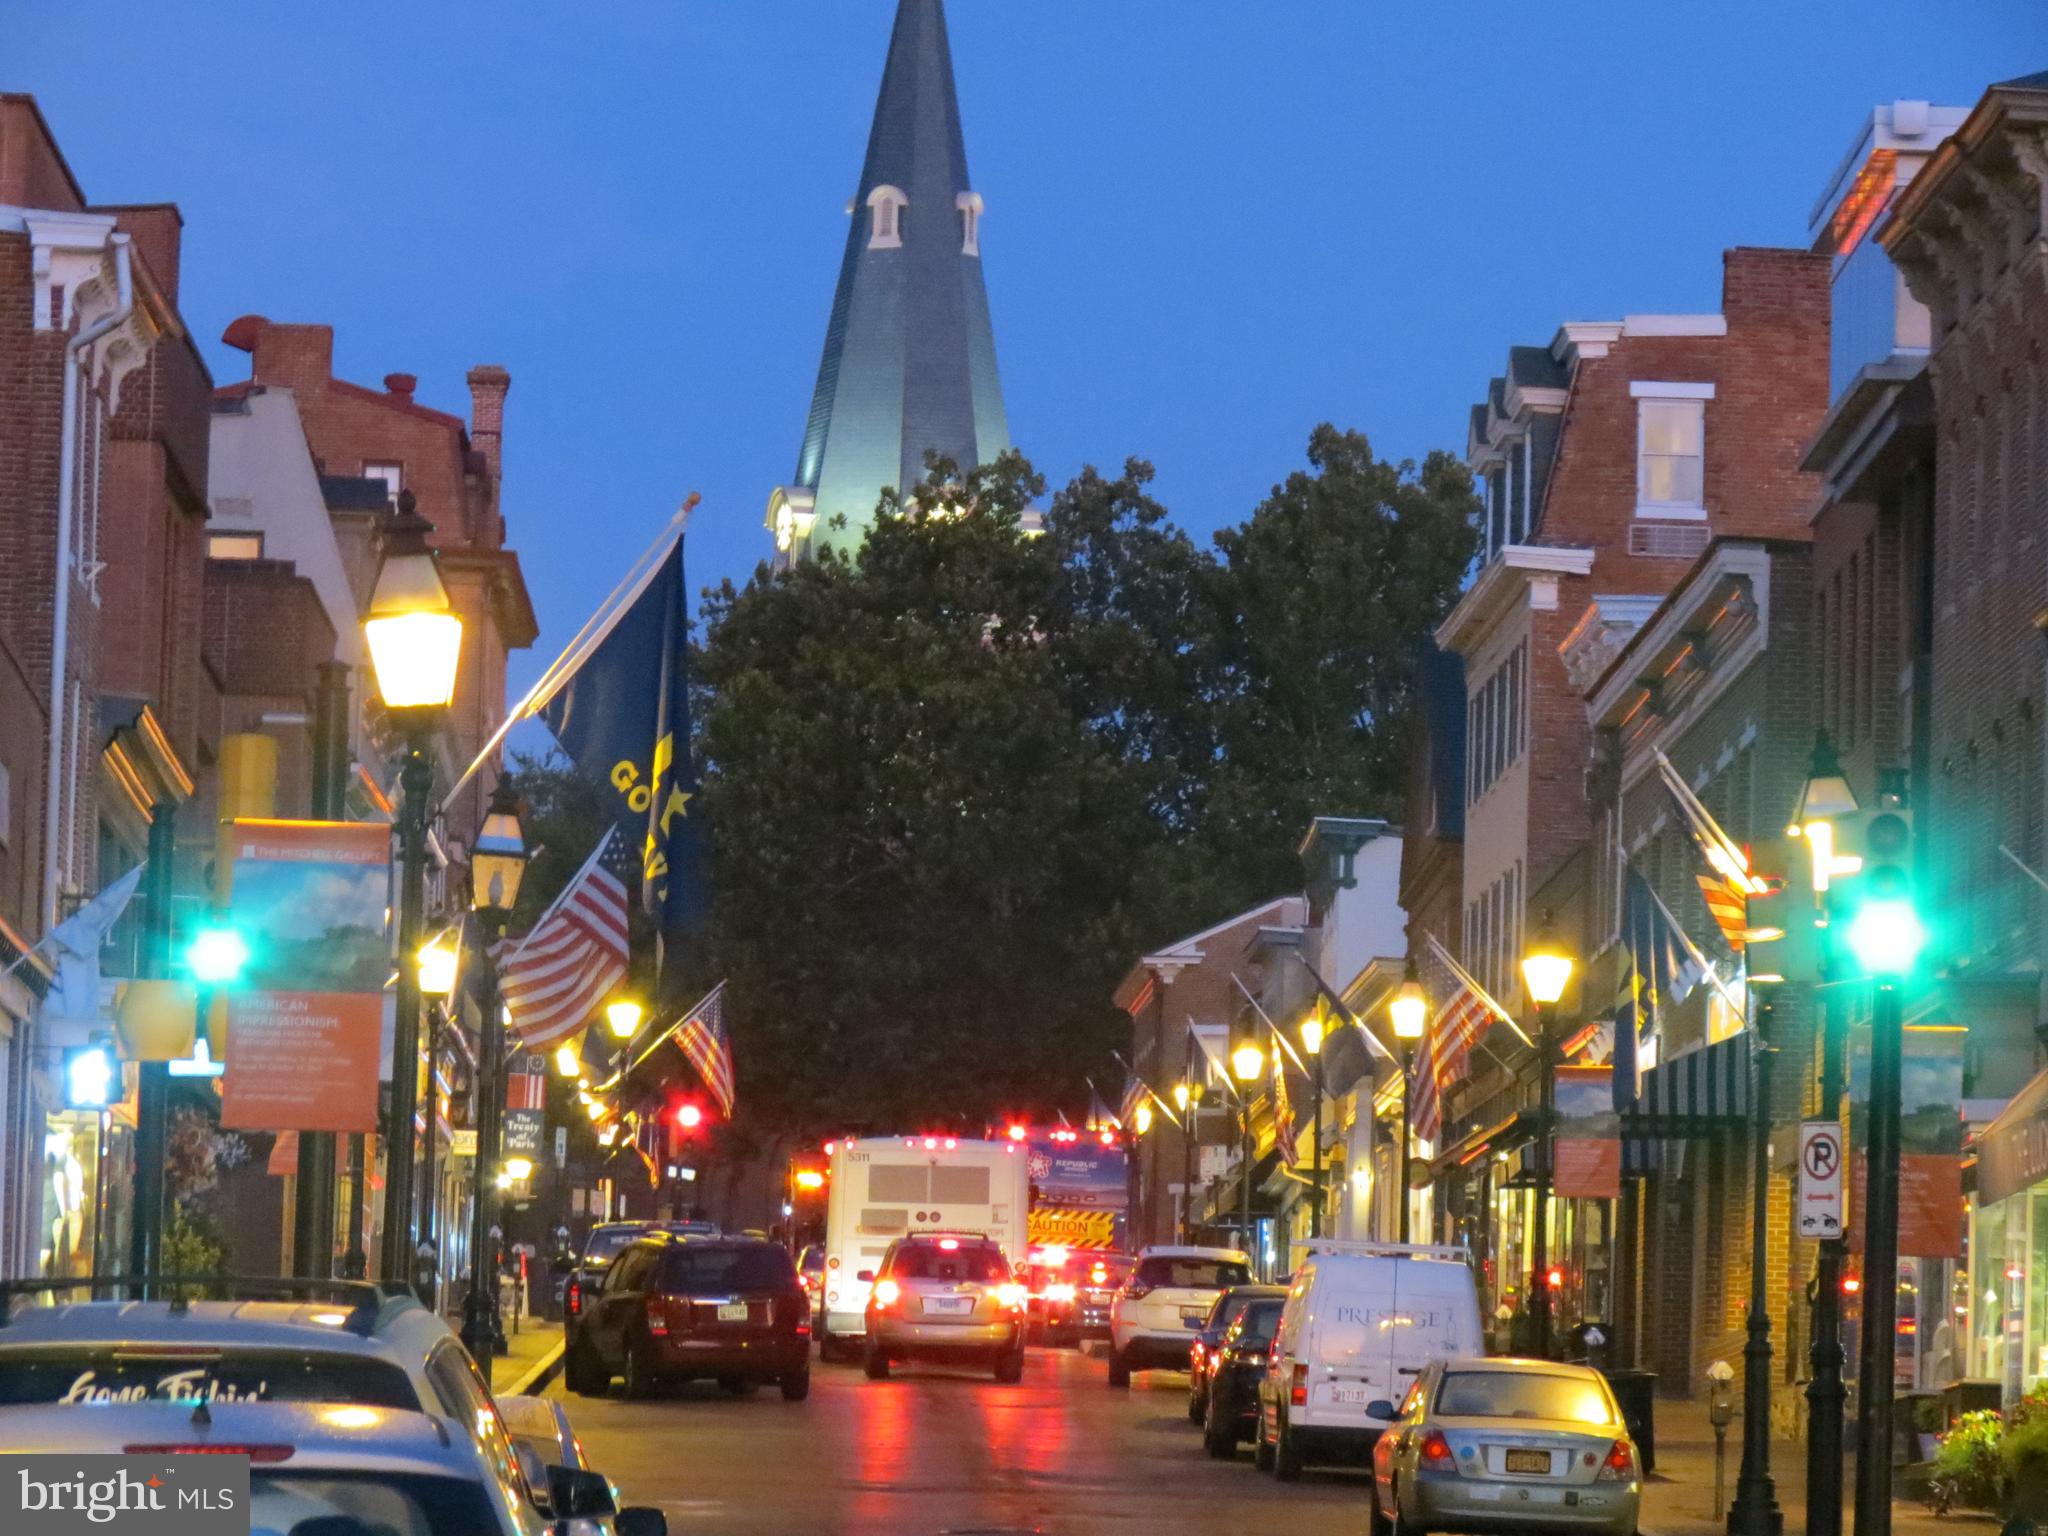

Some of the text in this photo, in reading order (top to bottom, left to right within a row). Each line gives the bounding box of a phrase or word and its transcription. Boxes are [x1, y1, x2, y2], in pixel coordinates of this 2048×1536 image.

[610, 760, 651, 813] GO
[238, 999, 309, 1011] AMERICAN
[238, 1015, 338, 1028] IMPRESSIONISM
[516, 1113, 531, 1122] The
[507, 1120, 539, 1134] Treaty
[507, 1137, 535, 1149] Paris
[848, 1152, 870, 1162] 5311
[1055, 1160, 1098, 1169] REPUBLIC
[1028, 1219, 1088, 1233] AUTION
